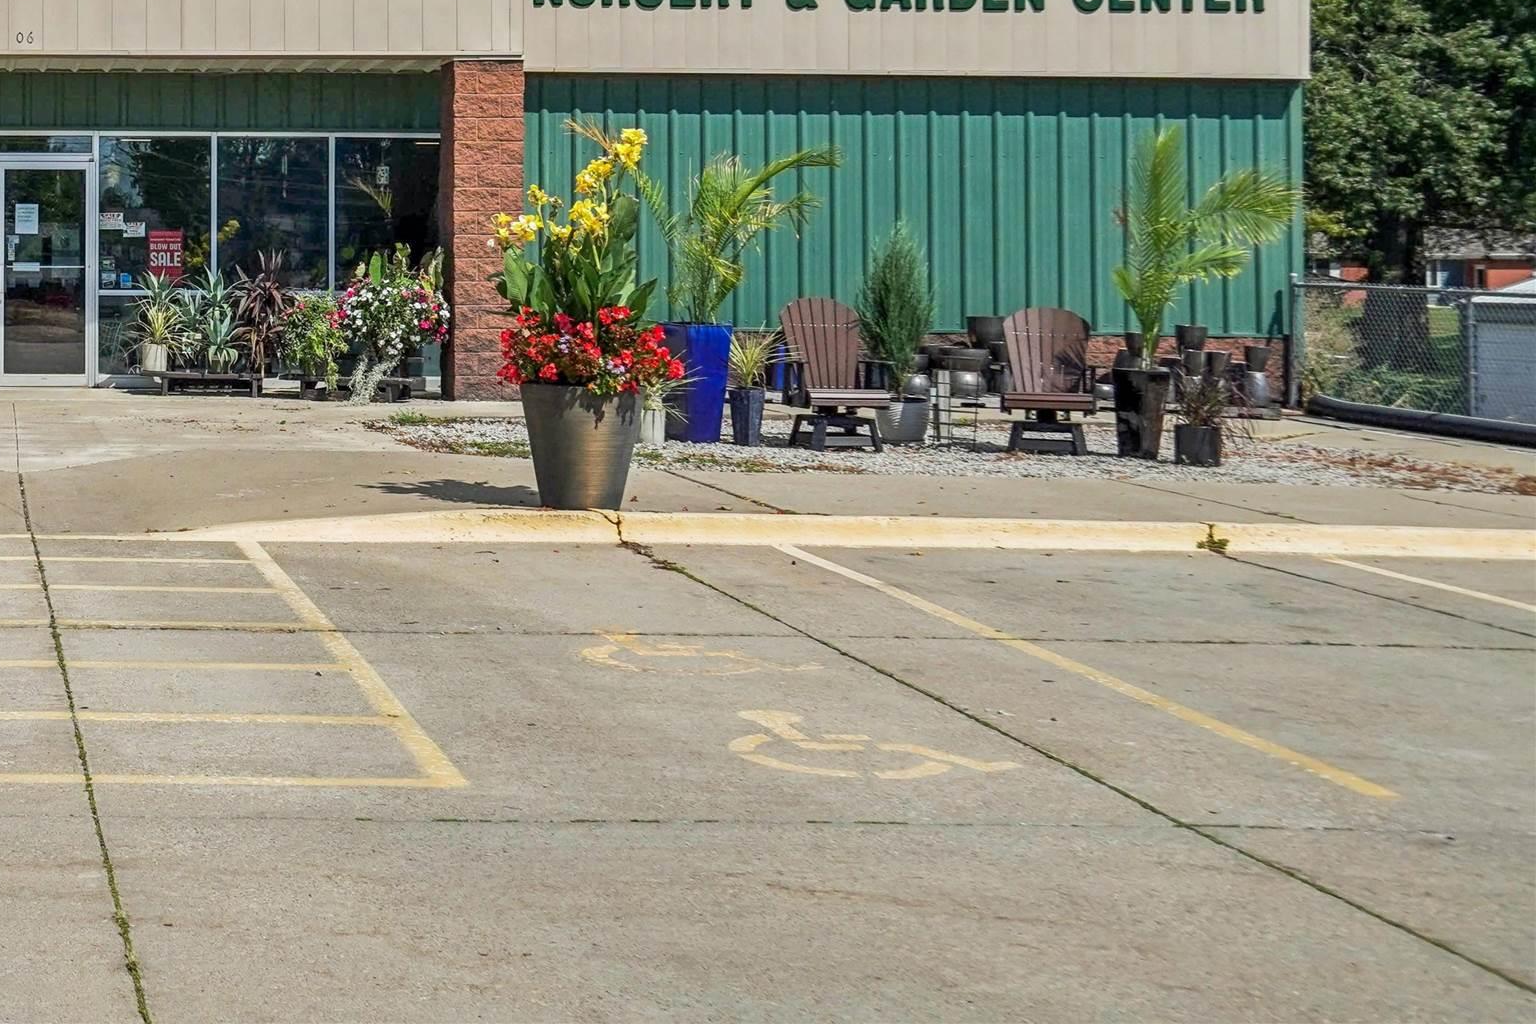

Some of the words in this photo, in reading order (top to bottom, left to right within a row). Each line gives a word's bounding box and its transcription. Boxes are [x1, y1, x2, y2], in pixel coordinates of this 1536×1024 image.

[150, 243, 168, 251] BLOW
[169, 243, 182, 251] OUT
[150, 251, 182, 267] SALE
